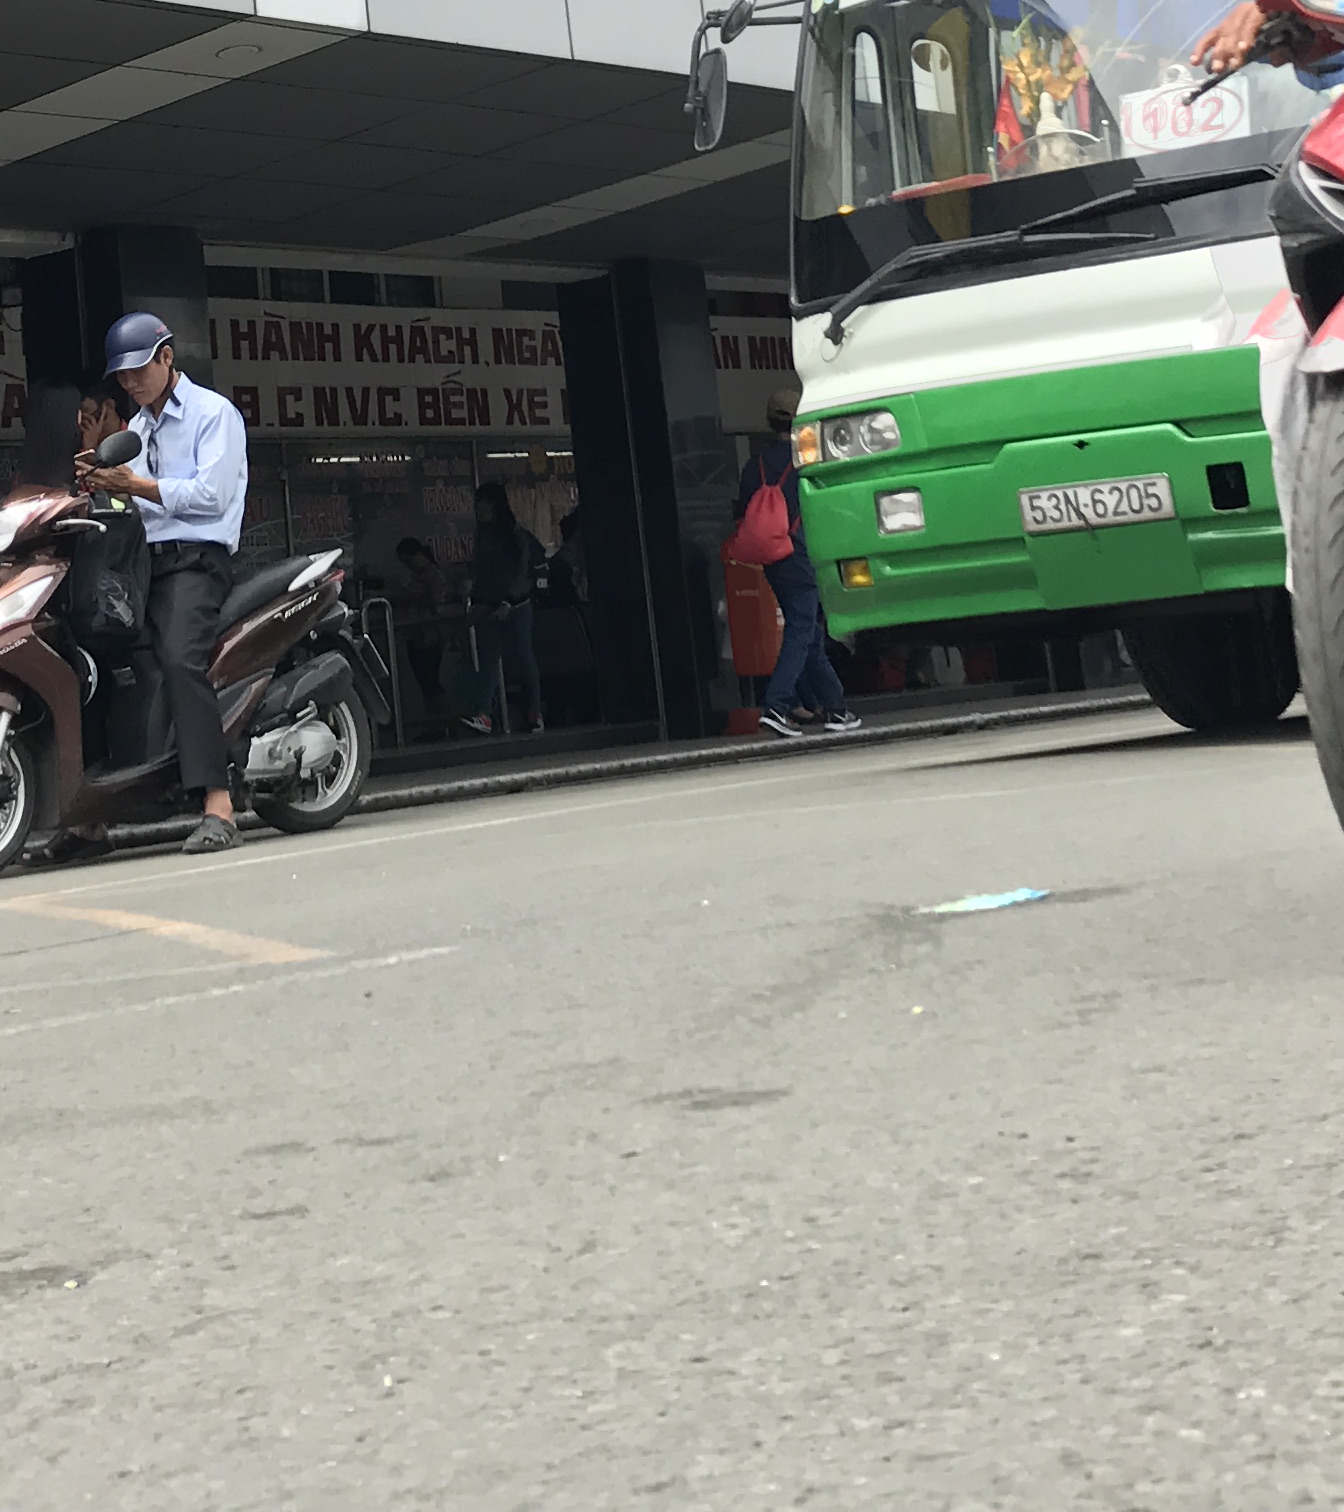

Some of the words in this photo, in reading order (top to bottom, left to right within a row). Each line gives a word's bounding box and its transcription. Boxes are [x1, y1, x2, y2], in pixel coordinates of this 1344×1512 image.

[230, 310, 342, 363] HÀNH
[417, 369, 492, 427] BẾN
[504, 387, 551, 427] XE
[1027, 481, 1164, 526] 53N-6205
